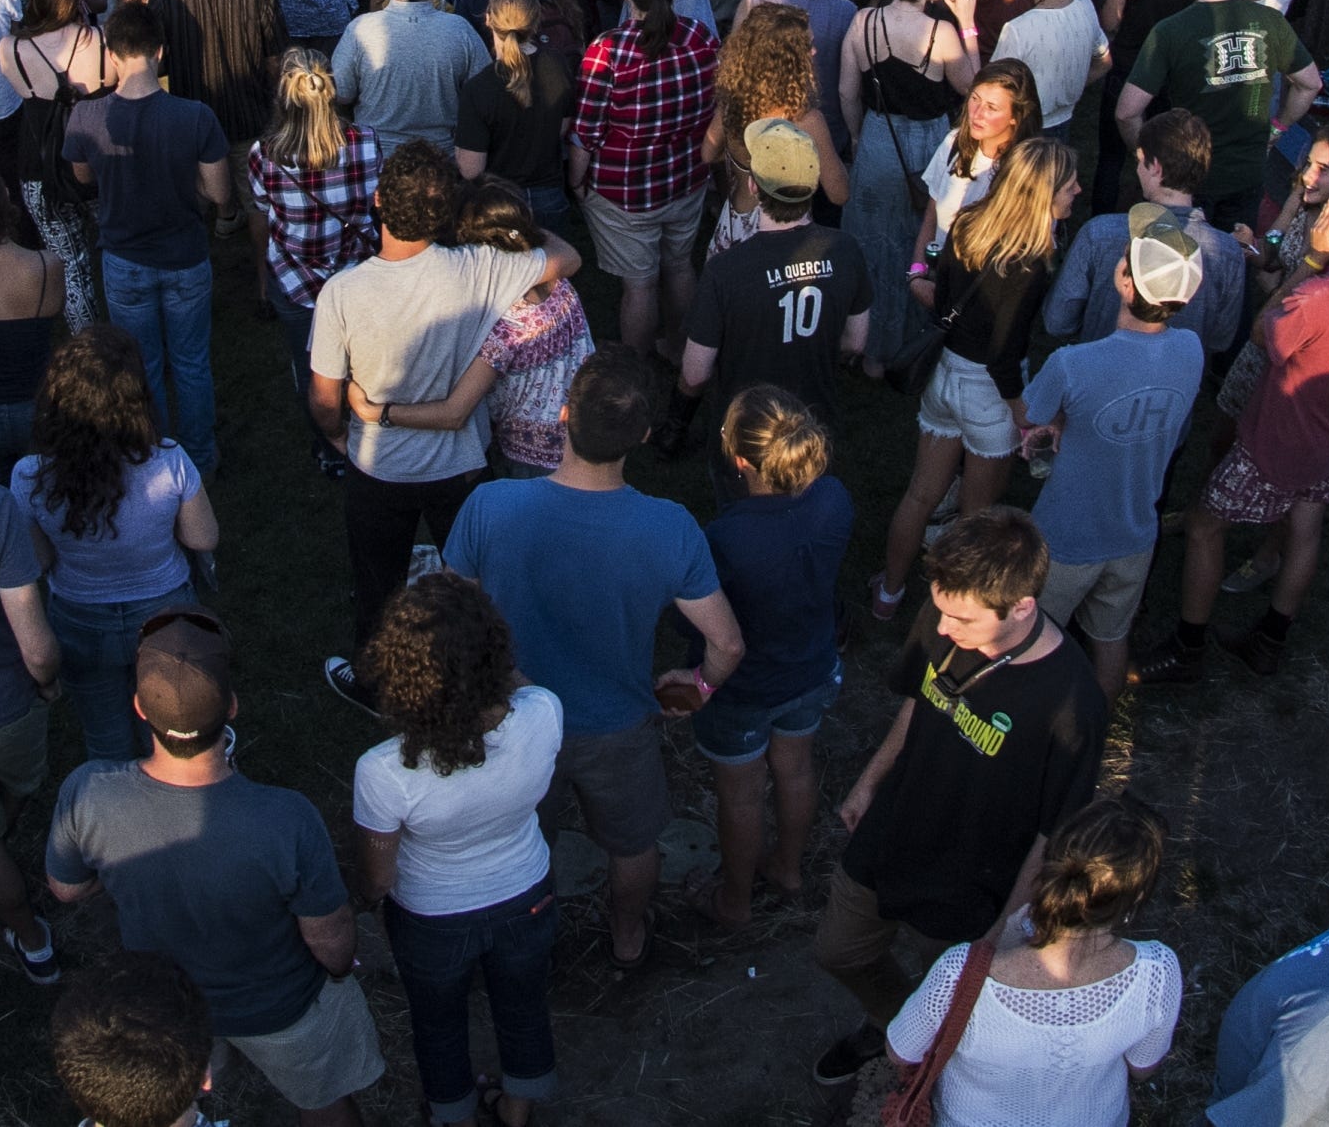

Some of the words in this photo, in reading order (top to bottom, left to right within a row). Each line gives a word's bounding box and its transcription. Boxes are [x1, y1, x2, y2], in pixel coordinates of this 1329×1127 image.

[766, 269, 782, 284] LA
[784, 259, 833, 279] QUERCIA
[778, 285, 823, 344] 10
[1112, 392, 1174, 435] JH
[953, 702, 1006, 757] GROUND
